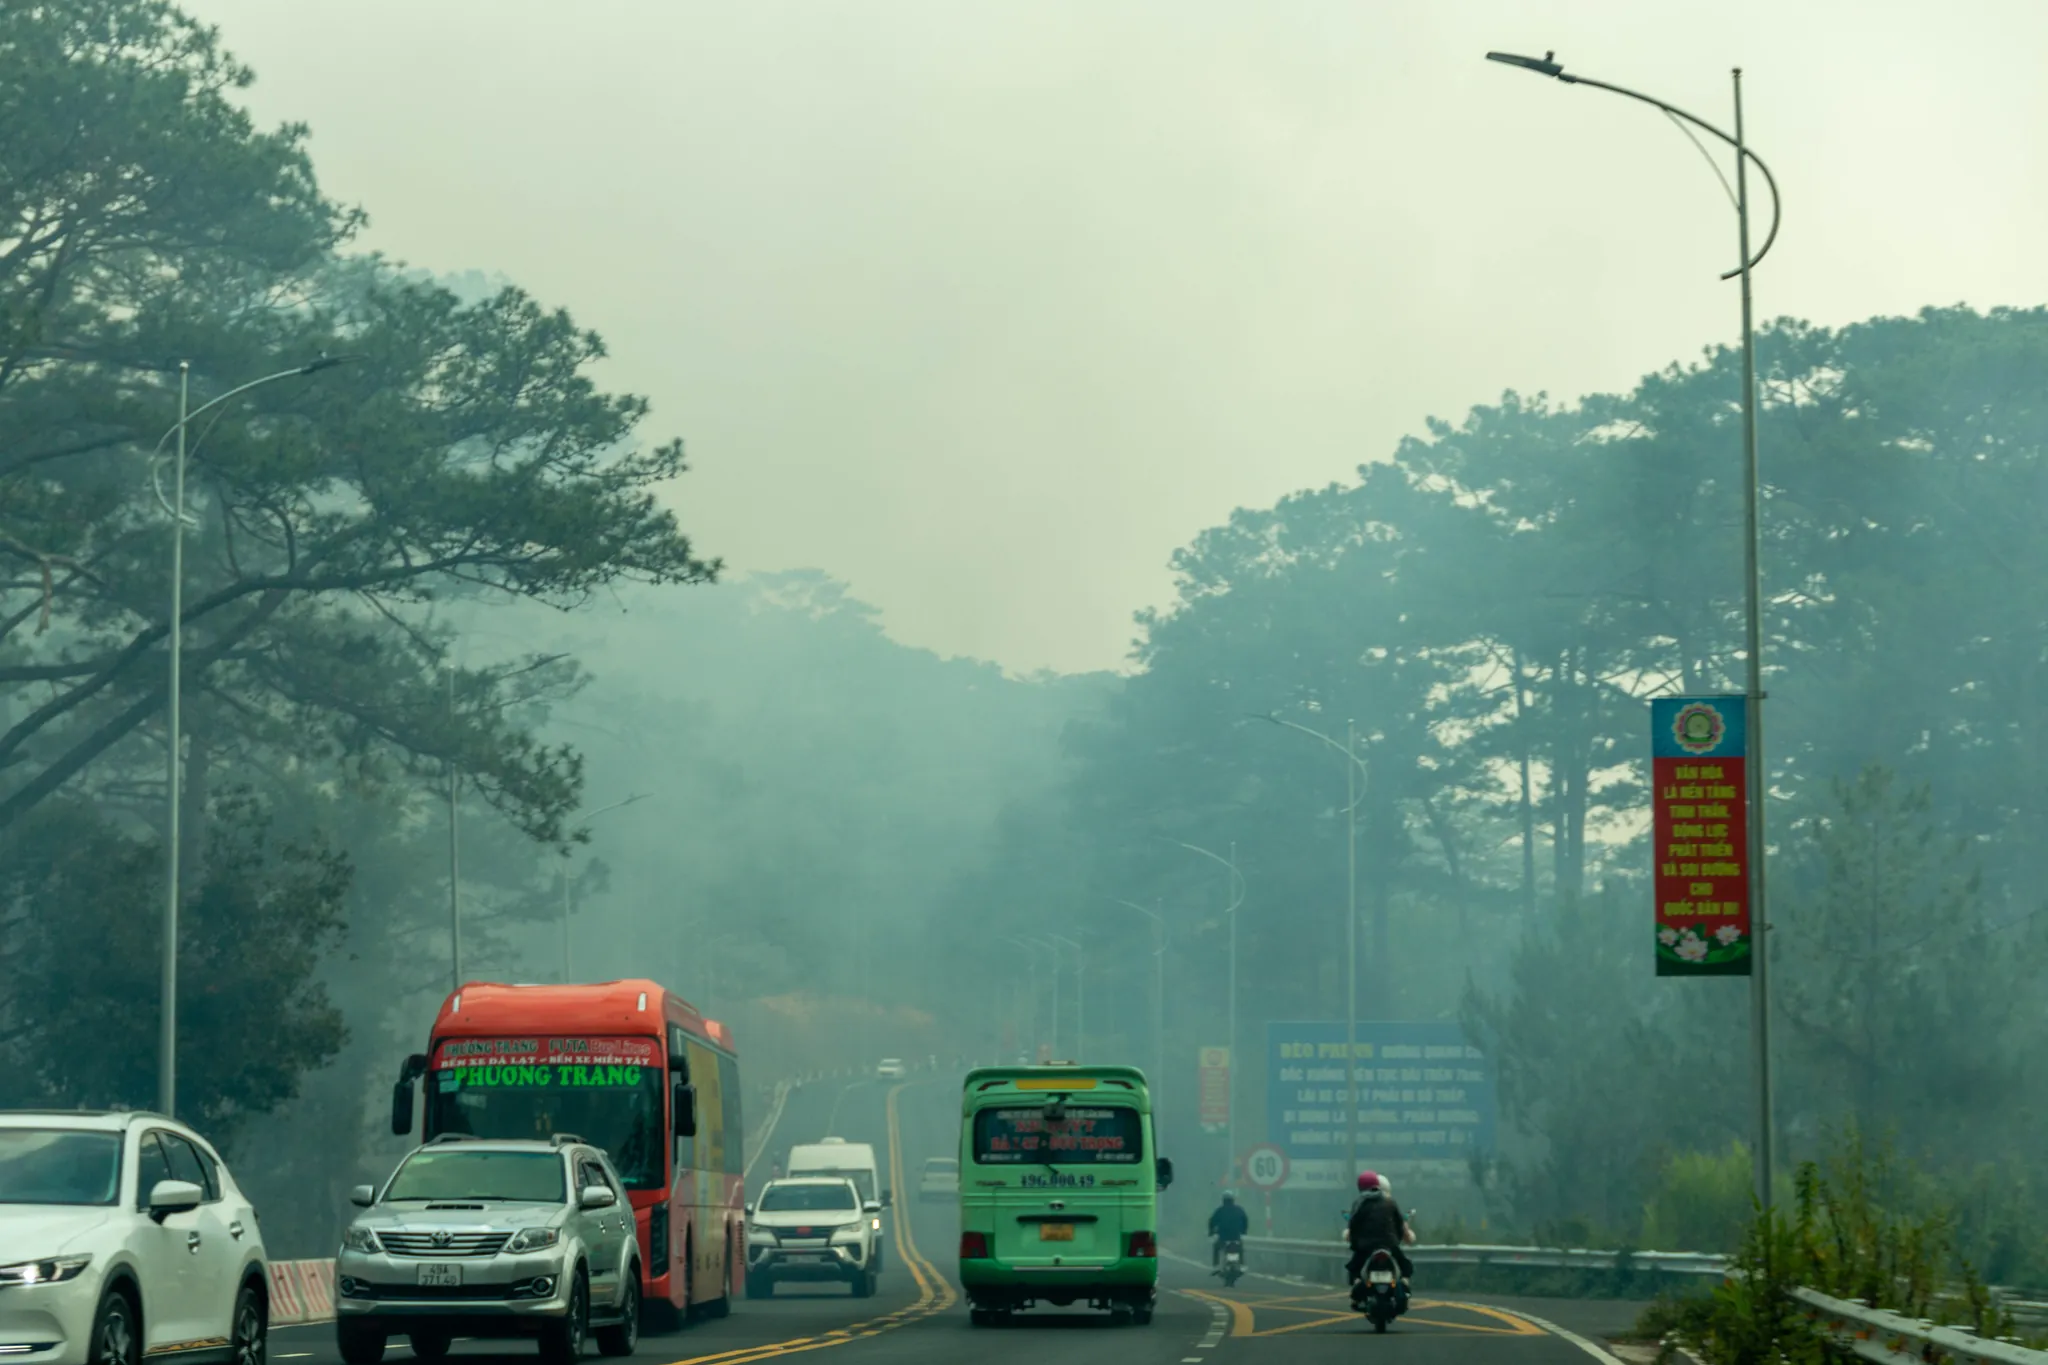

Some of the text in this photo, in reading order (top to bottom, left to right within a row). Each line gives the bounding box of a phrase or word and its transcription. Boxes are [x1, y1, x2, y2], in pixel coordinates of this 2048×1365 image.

[549, 1039, 589, 1053] FUTA
[558, 1065, 641, 1087] TRANG
[1254, 1156, 1277, 1178] 60
